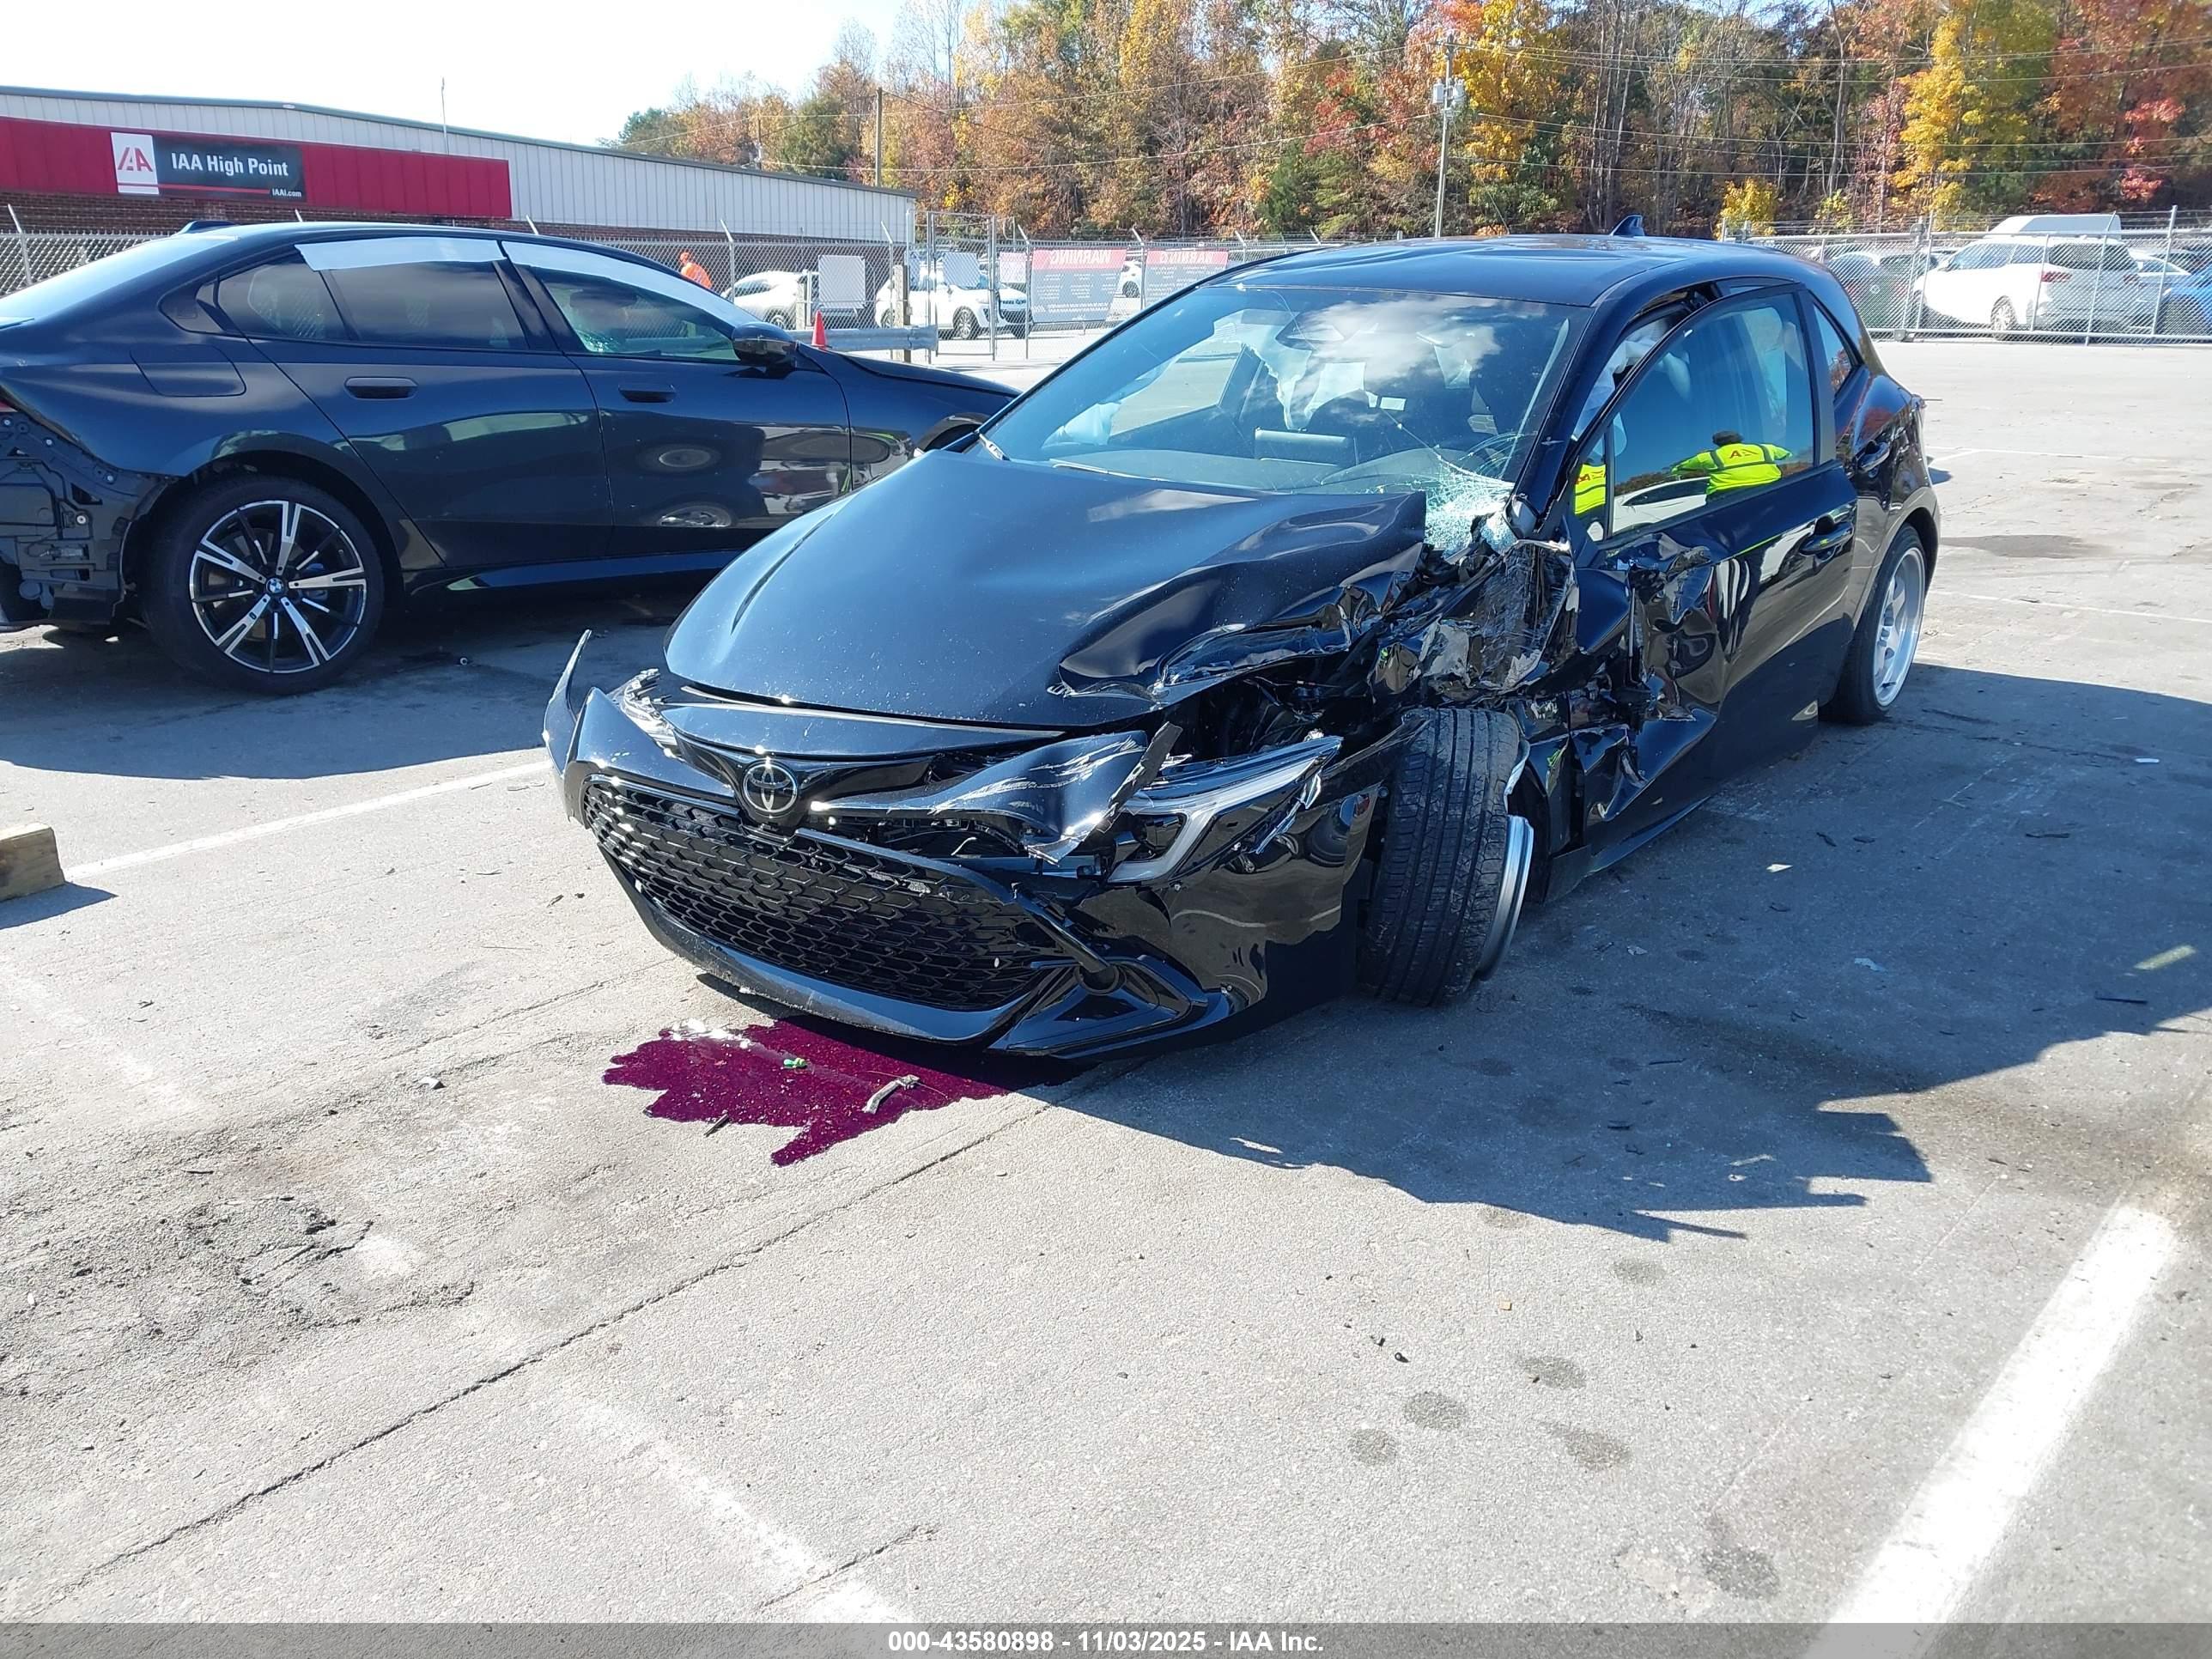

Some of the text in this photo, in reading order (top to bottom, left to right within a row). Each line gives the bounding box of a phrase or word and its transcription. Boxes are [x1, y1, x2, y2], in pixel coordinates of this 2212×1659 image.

[171, 152, 289, 177] IAA High Point
